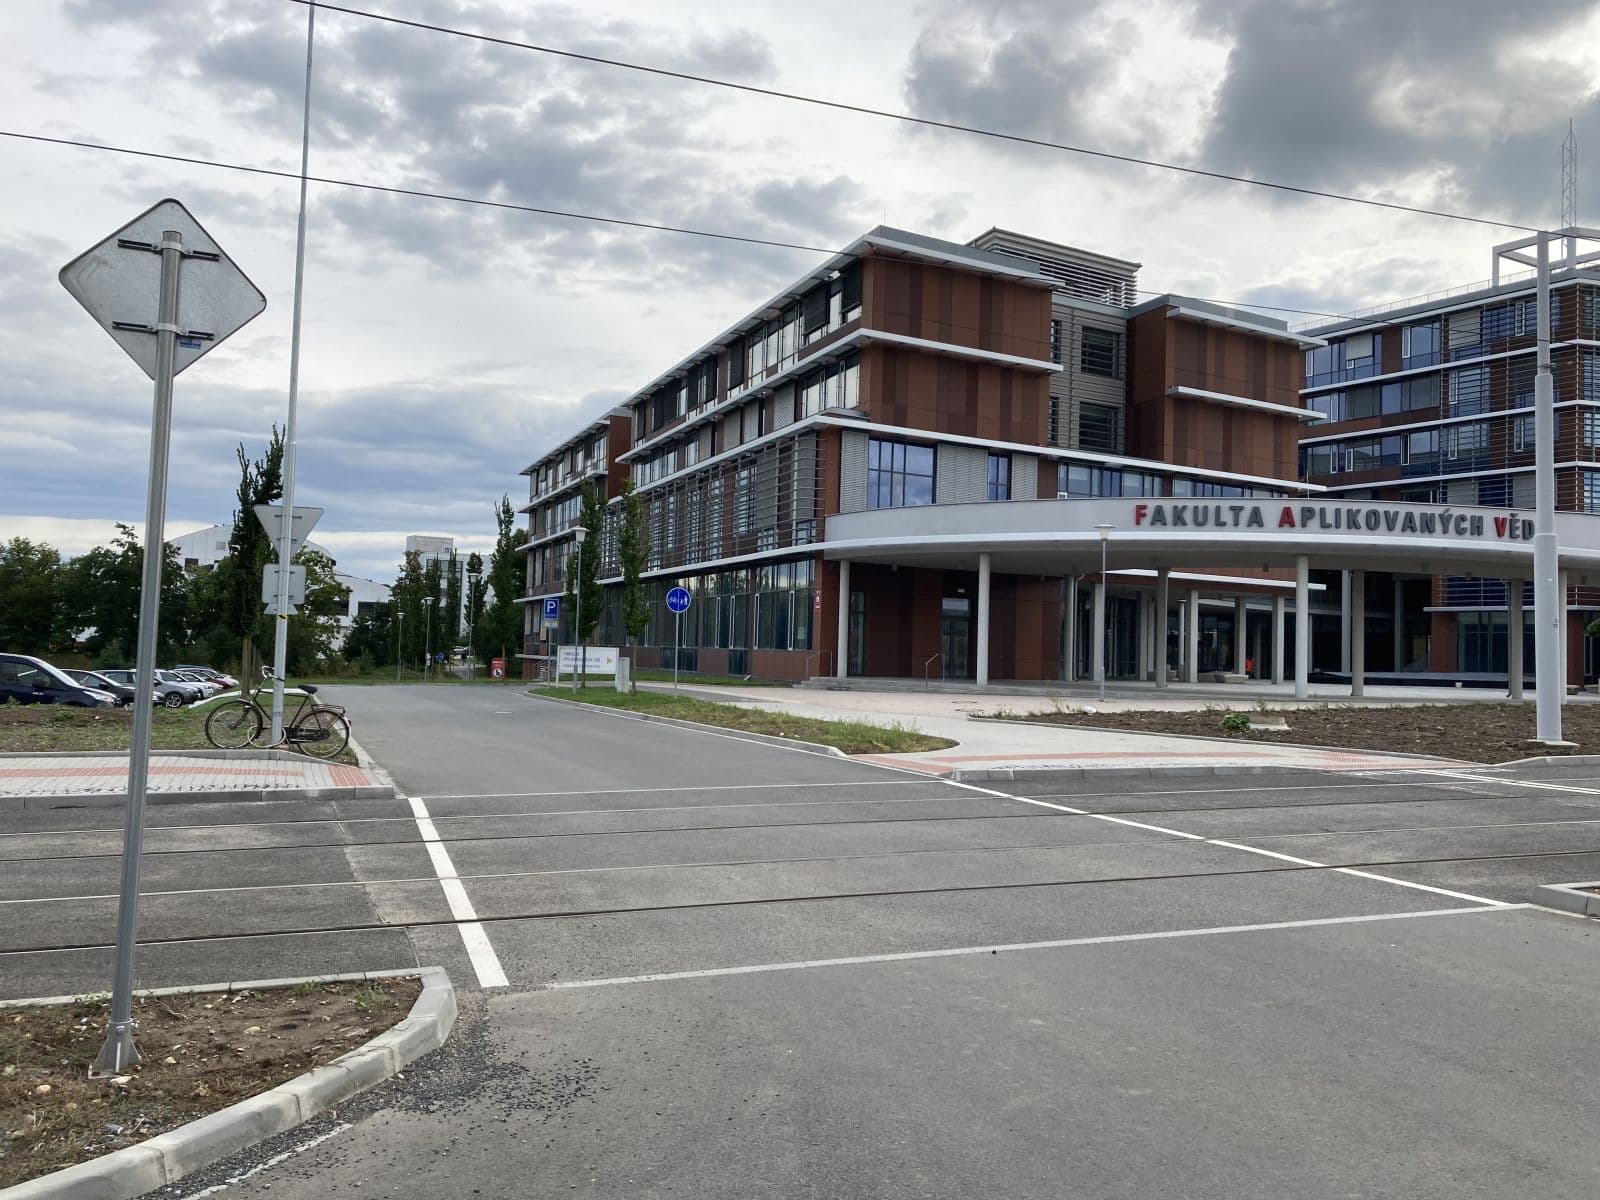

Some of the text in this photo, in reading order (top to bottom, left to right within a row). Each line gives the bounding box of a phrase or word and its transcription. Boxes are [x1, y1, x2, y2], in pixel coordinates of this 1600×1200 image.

[1135, 504, 1536, 540] FAKULTA APLIKOVANÝCH VĚD
[546, 601, 556, 613] P
